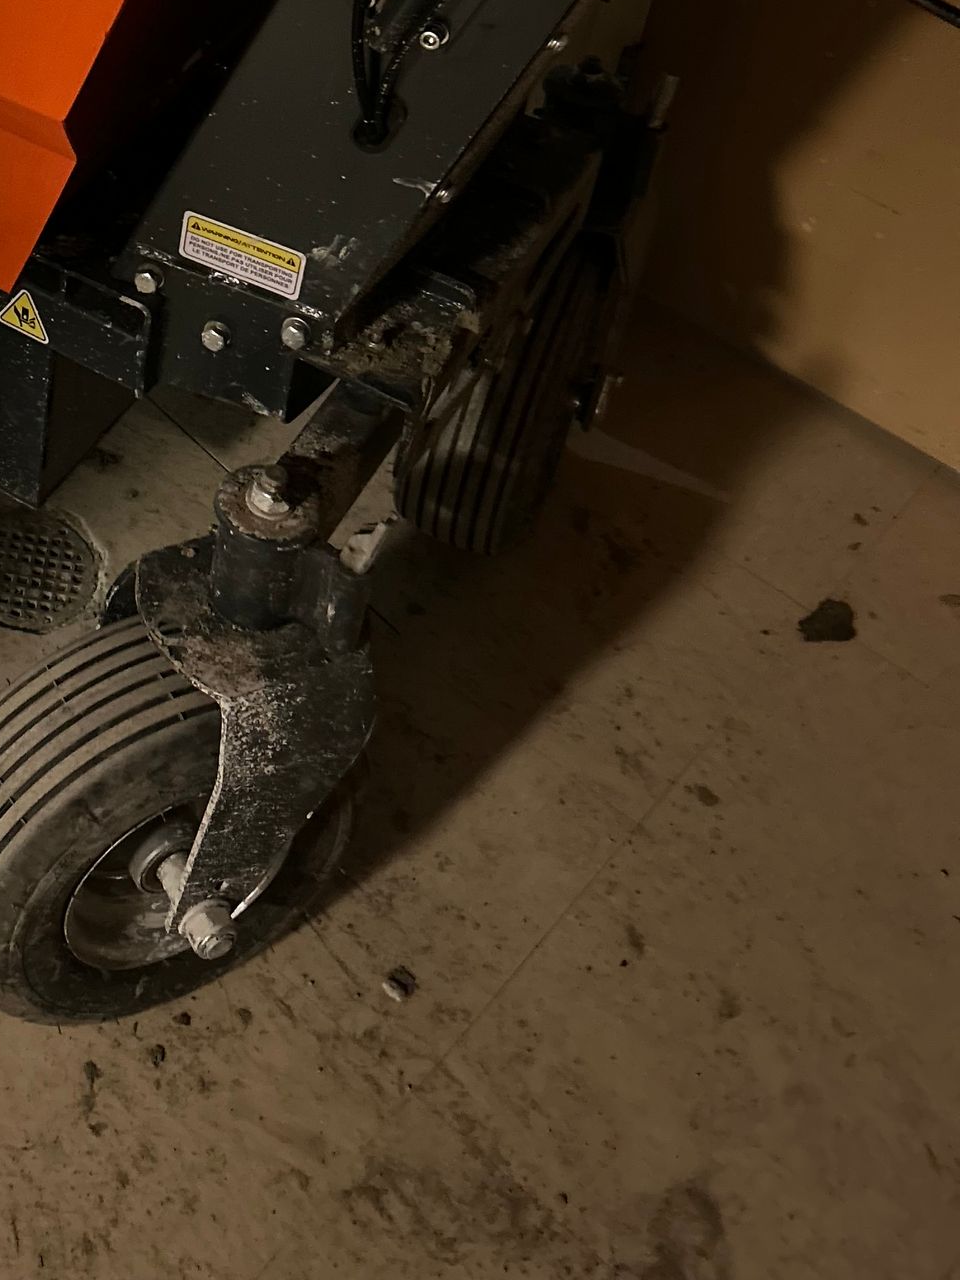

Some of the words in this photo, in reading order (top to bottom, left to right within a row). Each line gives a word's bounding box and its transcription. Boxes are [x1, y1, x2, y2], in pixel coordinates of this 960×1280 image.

[191, 247, 202, 256] LE
[201, 251, 240, 269] TRANSPORT
[239, 265, 249, 273] DE
[249, 269, 290, 289] PERSONNES
[201, 239, 215, 247] NOT
[215, 243, 228, 253] USE
[229, 248, 244, 258] FOR
[244, 254, 293, 279] TRANSPORTING
[231, 256, 244, 266] PAS
[244, 260, 274, 276] UTILISER
[274, 272, 293, 284] POUR
